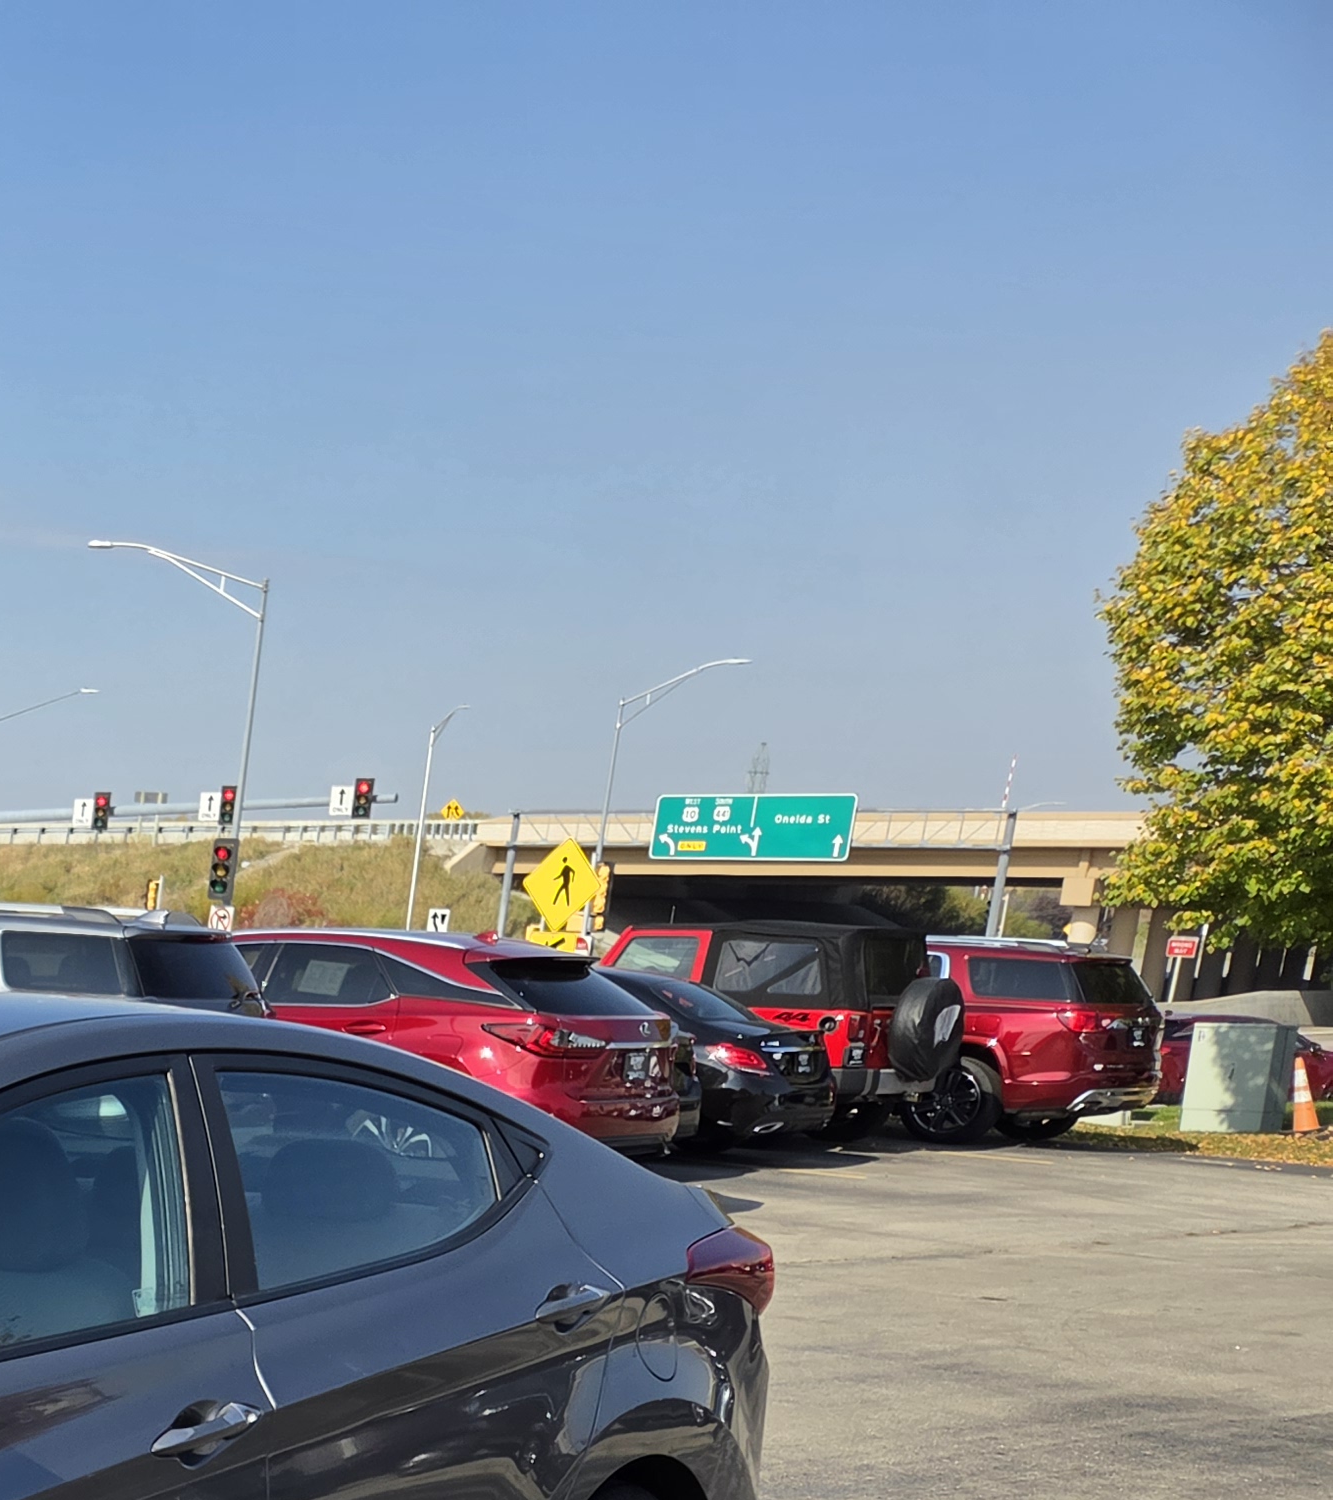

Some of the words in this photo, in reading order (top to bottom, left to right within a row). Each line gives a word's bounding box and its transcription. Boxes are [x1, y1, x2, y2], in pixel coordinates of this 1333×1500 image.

[686, 810, 696, 819] 10
[774, 813, 813, 824] Oneida
[817, 813, 831, 824] St
[666, 824, 708, 834] Stevens
[713, 824, 742, 834] Point
[680, 842, 703, 850] ONLY
